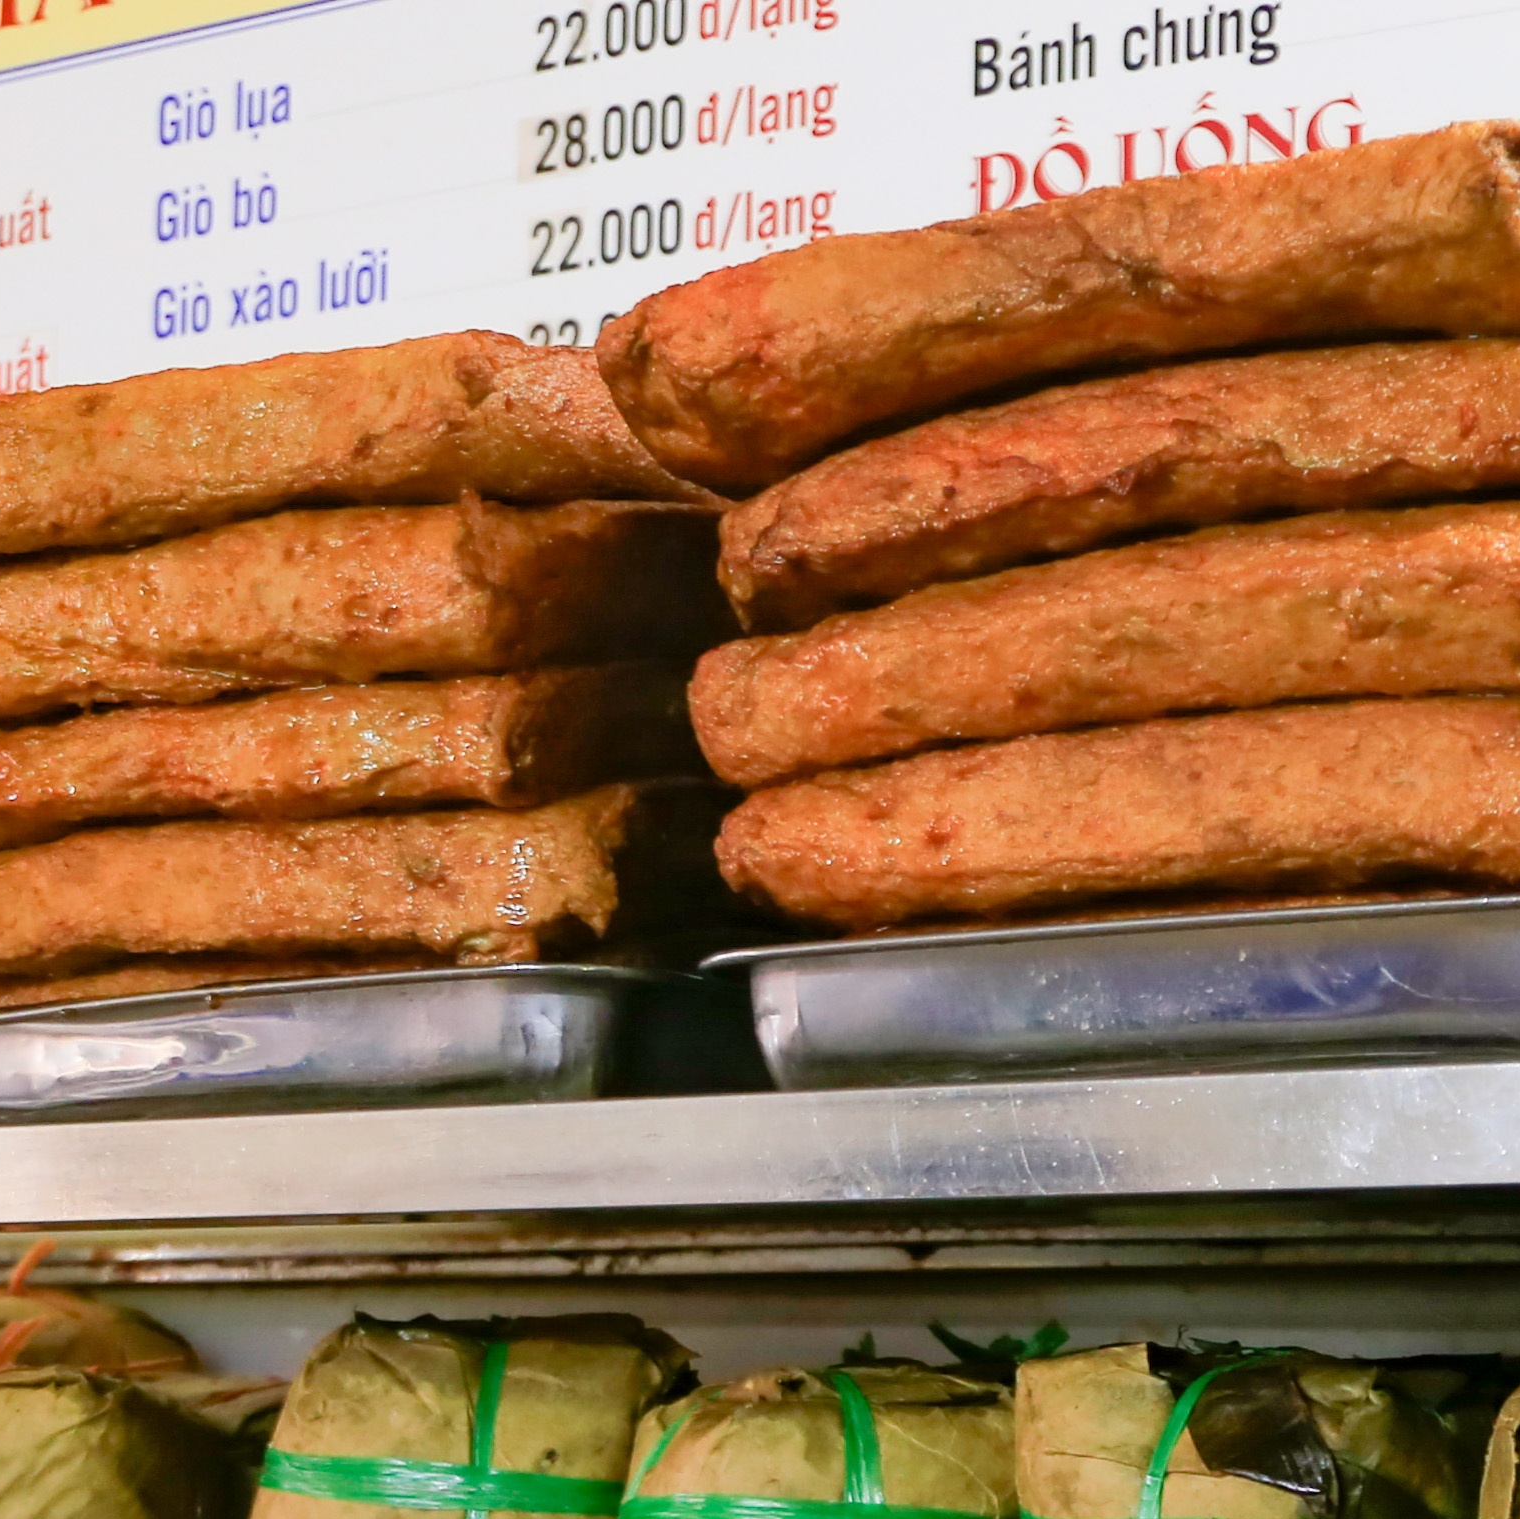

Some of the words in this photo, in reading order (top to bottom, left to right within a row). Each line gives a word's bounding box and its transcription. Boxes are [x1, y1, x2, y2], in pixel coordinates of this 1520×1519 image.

[536, 0, 686, 71] 22.000
[974, 22, 1097, 97] Bánh
[1123, 1, 1282, 66] chưng
[159, 87, 216, 145] Giò
[235, 80, 291, 140] lụa
[536, 94, 684, 174] 28.000
[697, 82, 839, 146] đ/lạng
[969, 115, 1092, 214] ĐỒ
[1115, 90, 1367, 184] UỐNG
[157, 183, 213, 242] Giò
[233, 171, 277, 229] bò
[531, 198, 683, 277] 22.000
[695, 189, 837, 251] đ/lạng
[154, 280, 210, 340] Giò
[230, 269, 298, 327] xào
[319, 248, 389, 312] lưỡi
